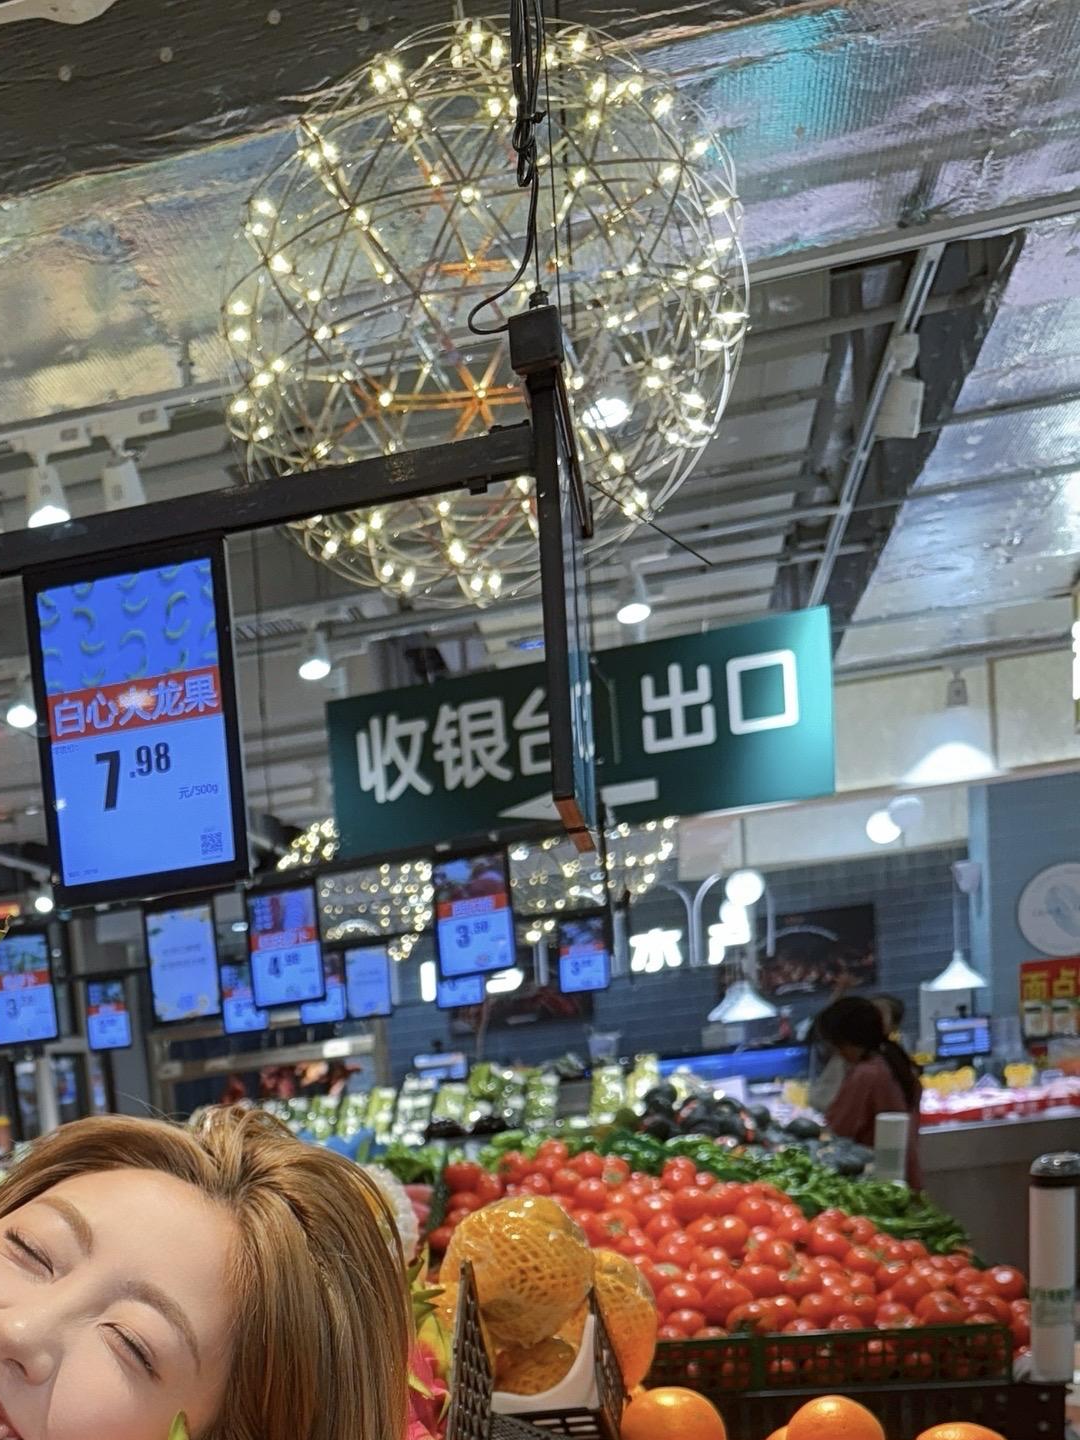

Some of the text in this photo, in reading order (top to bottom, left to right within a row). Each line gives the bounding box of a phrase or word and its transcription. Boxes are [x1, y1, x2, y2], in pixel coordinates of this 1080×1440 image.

[54, 674, 219, 737] 白心火龙果
[640, 648, 800, 755] 出口
[95, 742, 172, 812] 7.98
[178, 782, 219, 800] 元/500g
